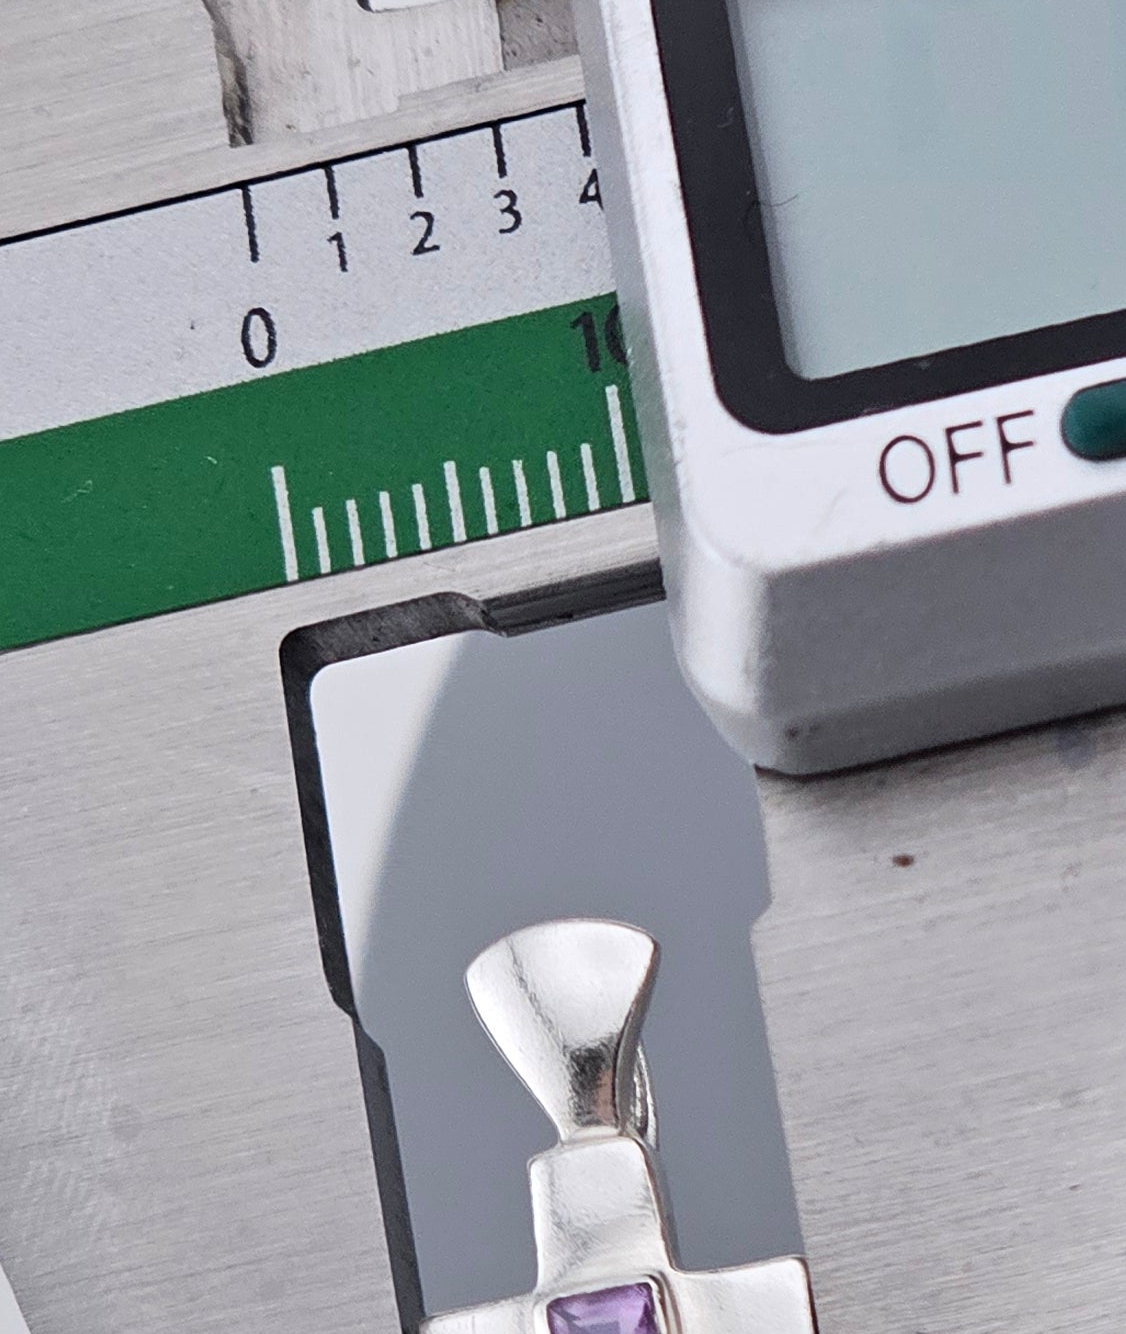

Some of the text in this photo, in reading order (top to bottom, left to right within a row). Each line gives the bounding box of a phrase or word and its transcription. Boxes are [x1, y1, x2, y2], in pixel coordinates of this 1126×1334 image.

[327, 169, 603, 272] 1 2 3 4
[240, 307, 277, 368] 0
[878, 410, 1034, 505] OFF
